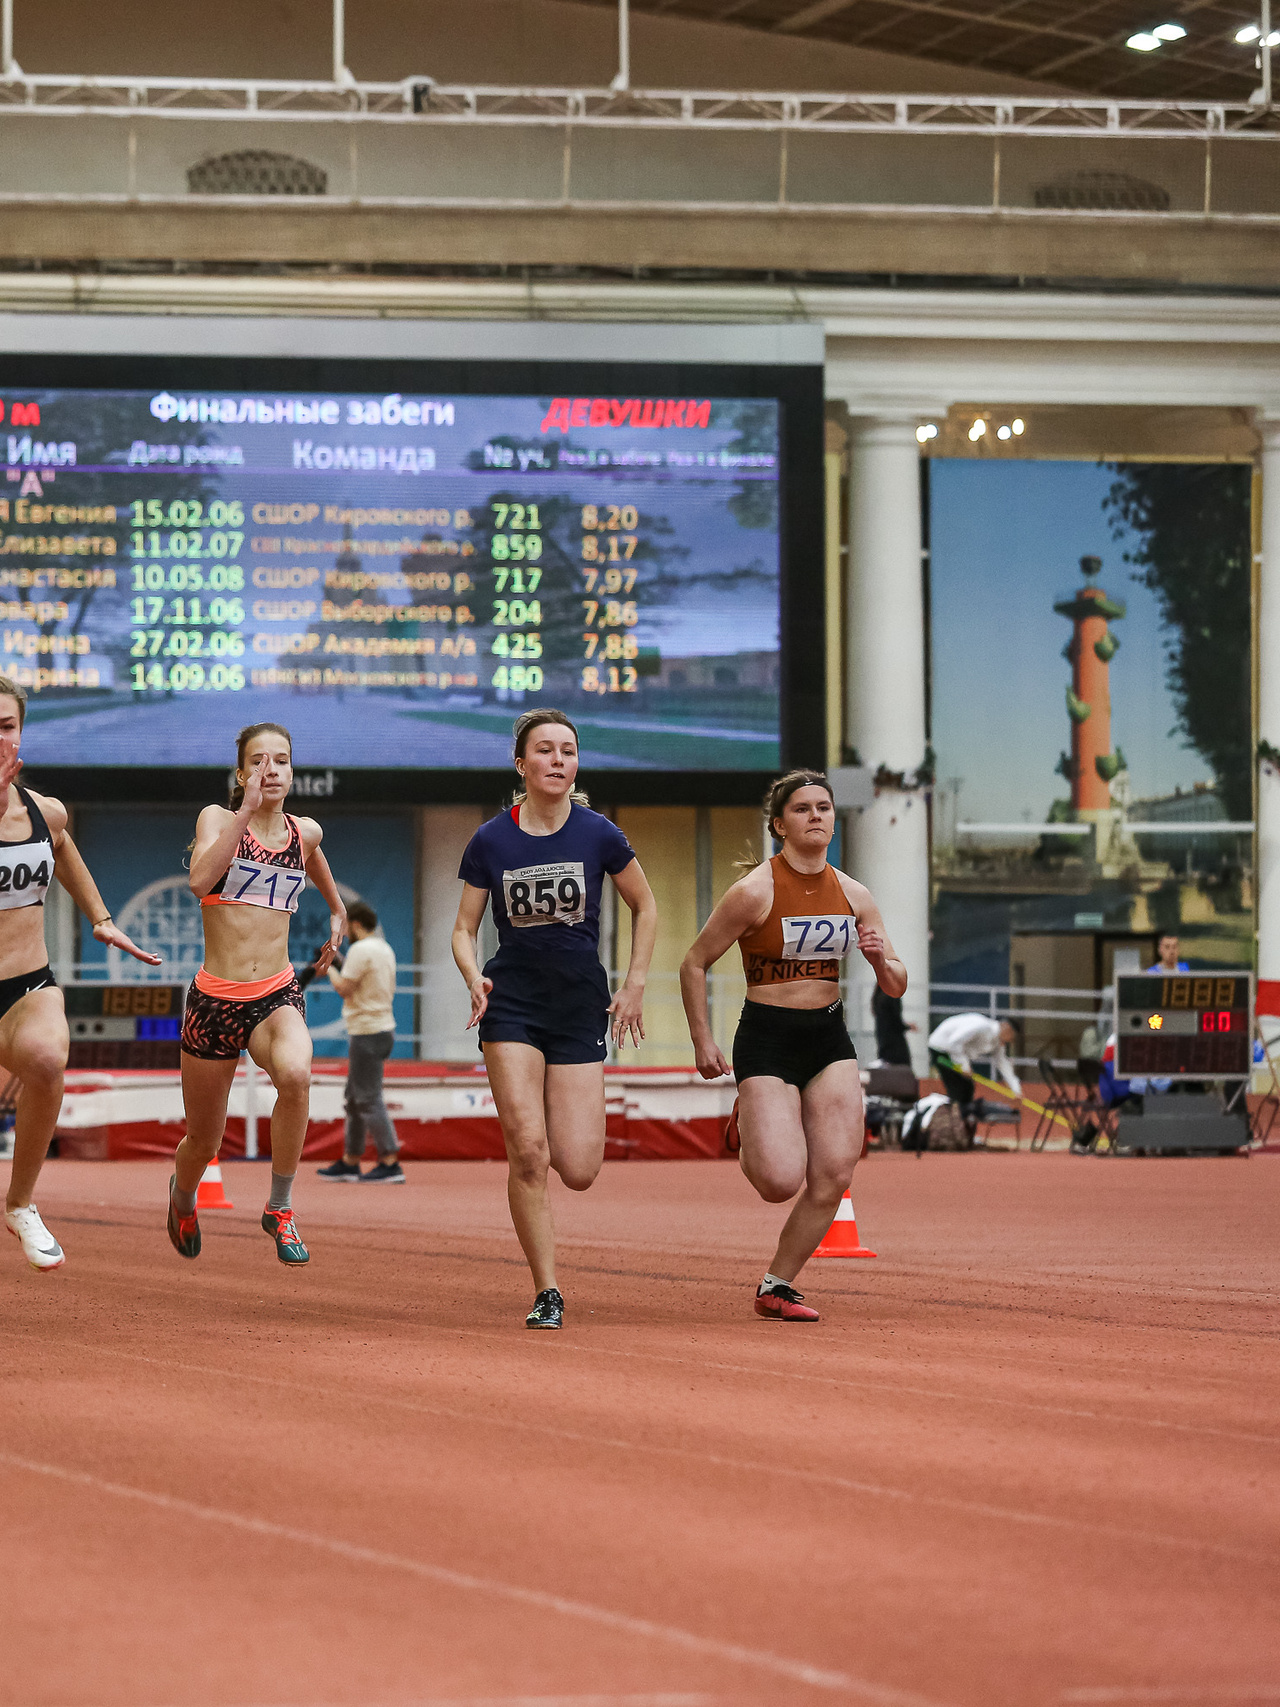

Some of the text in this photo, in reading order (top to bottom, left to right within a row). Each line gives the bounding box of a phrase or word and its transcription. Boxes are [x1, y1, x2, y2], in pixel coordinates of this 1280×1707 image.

[11, 401, 41, 427] м
[150, 391, 455, 426] Финальные забеги
[540, 398, 712, 433] ДЕВУШКИ
[7, 435, 77, 466] Имя
[293, 439, 436, 475] Команда
[15, 498, 117, 524] Евгения
[130, 499, 245, 528] 15.02.06
[491, 503, 543, 531] 721
[130, 530, 245, 559] 11.02.07
[491, 534, 543, 561] 859
[130, 564, 245, 592] 10.05.08
[492, 567, 542, 593] 717
[130, 596, 245, 625] 17.11.06
[492, 599, 543, 626] 204
[3, 629, 91, 657] Ирина
[130, 630, 245, 658] 27.02.06
[491, 632, 543, 659] 425
[130, 662, 245, 691] 14.09.06
[491, 665, 544, 692] 480
[234, 865, 302, 909] 717
[509, 877, 581, 917] 859
[790, 919, 850, 953] 721
[771, 961, 817, 980] NIKE
